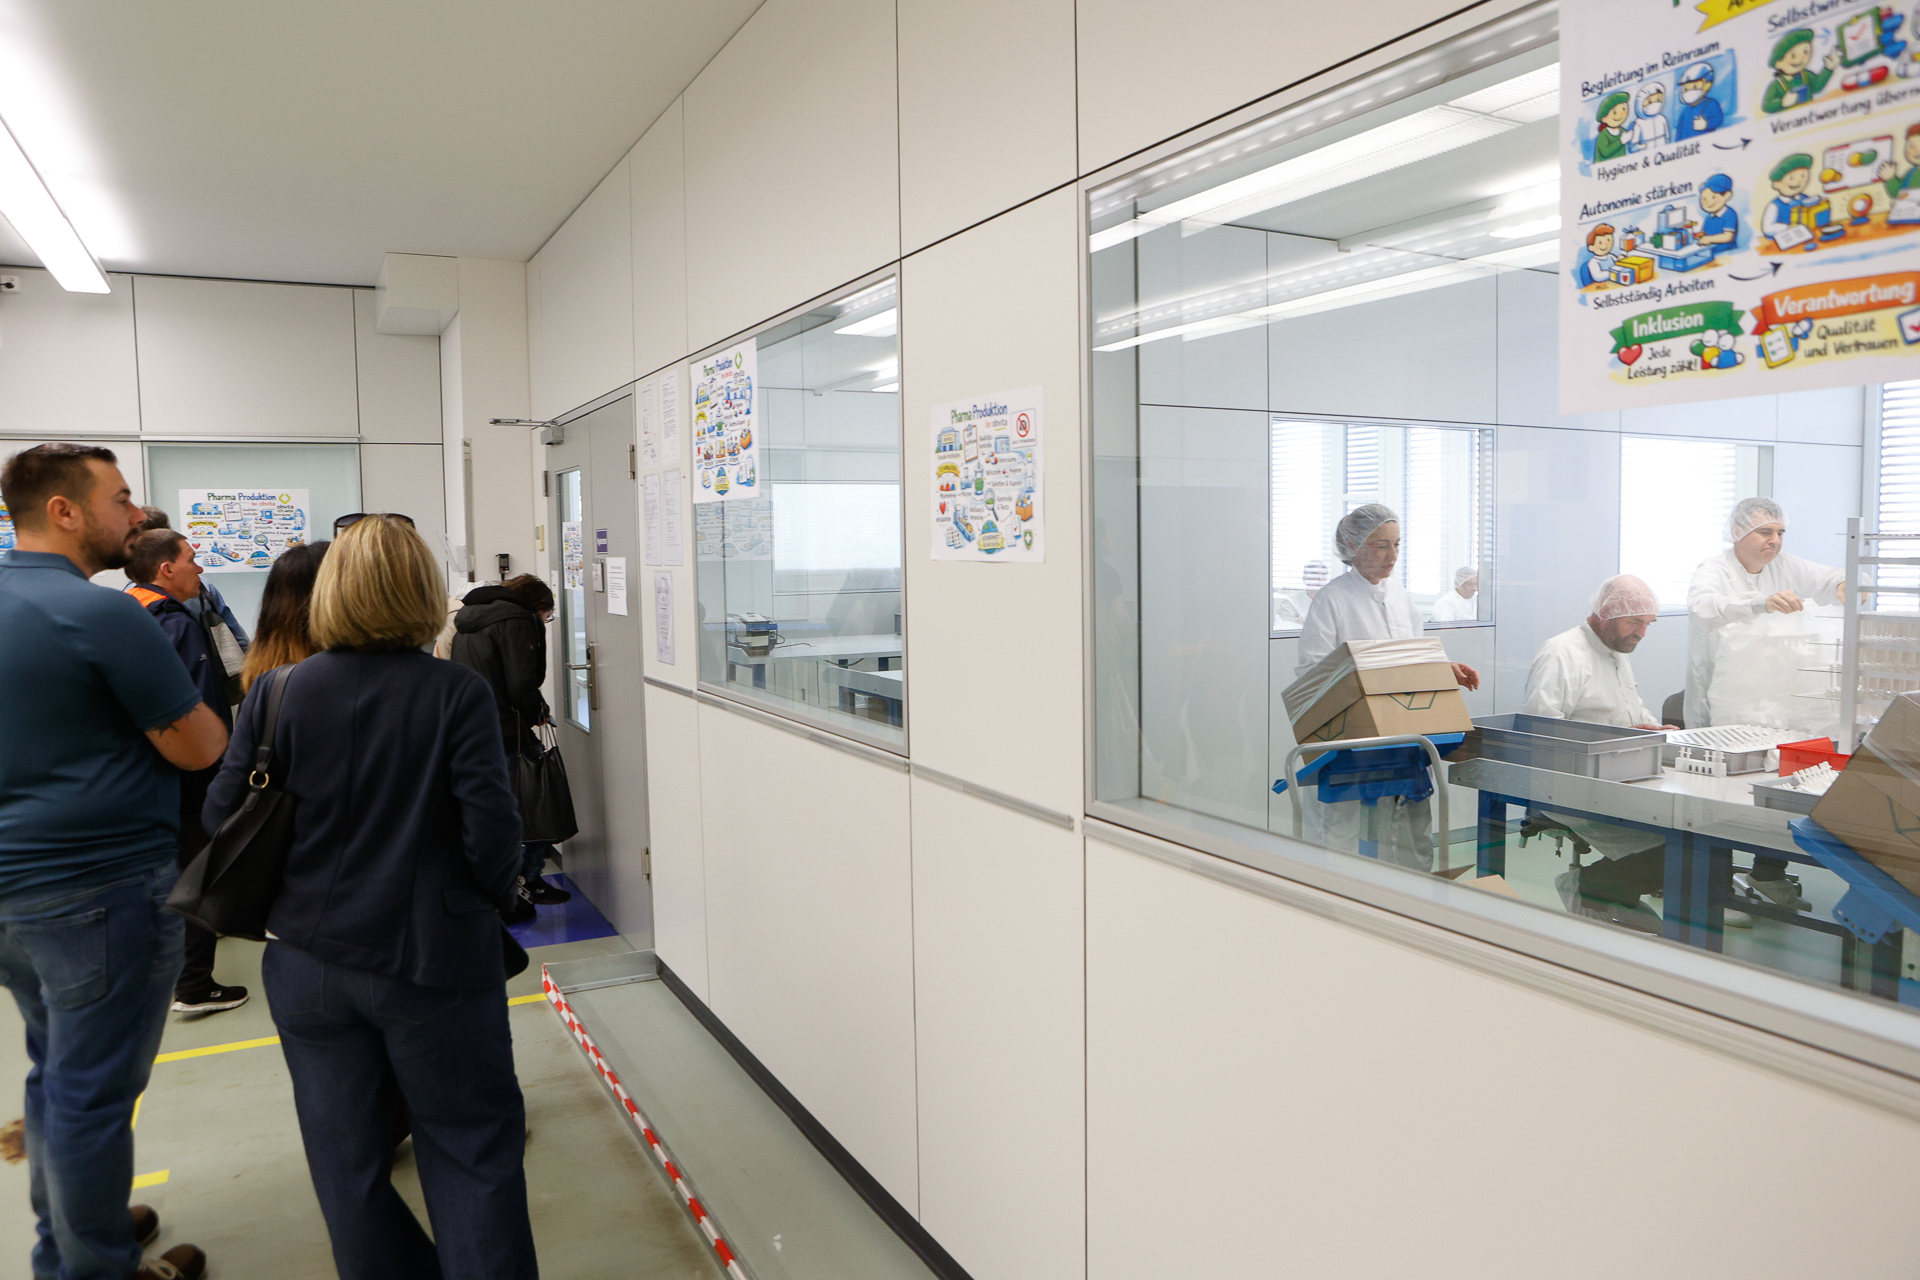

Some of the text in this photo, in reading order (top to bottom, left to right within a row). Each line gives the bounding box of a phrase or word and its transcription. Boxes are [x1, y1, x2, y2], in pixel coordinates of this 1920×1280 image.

[1581, 41, 1720, 97] Begleitung im Reinraum
[1770, 100, 1872, 134] Verantwortung
[1597, 142, 1701, 182] Hygiene & Qualität
[1579, 181, 1692, 220] Autonomie stärken
[1593, 279, 1715, 310] Selbstständig Arbeiten
[1774, 281, 1916, 317] Verantwortung
[1632, 311, 1704, 338] Inklusion
[1817, 318, 1876, 339] Qualität
[1648, 345, 1671, 360] Jede
[1804, 338, 1898, 358] und Vertrauen
[1628, 363, 1666, 379] Leistung
[951, 402, 1007, 424] Pharma Produktion
[207, 492, 276, 501] Pharma Produktion
